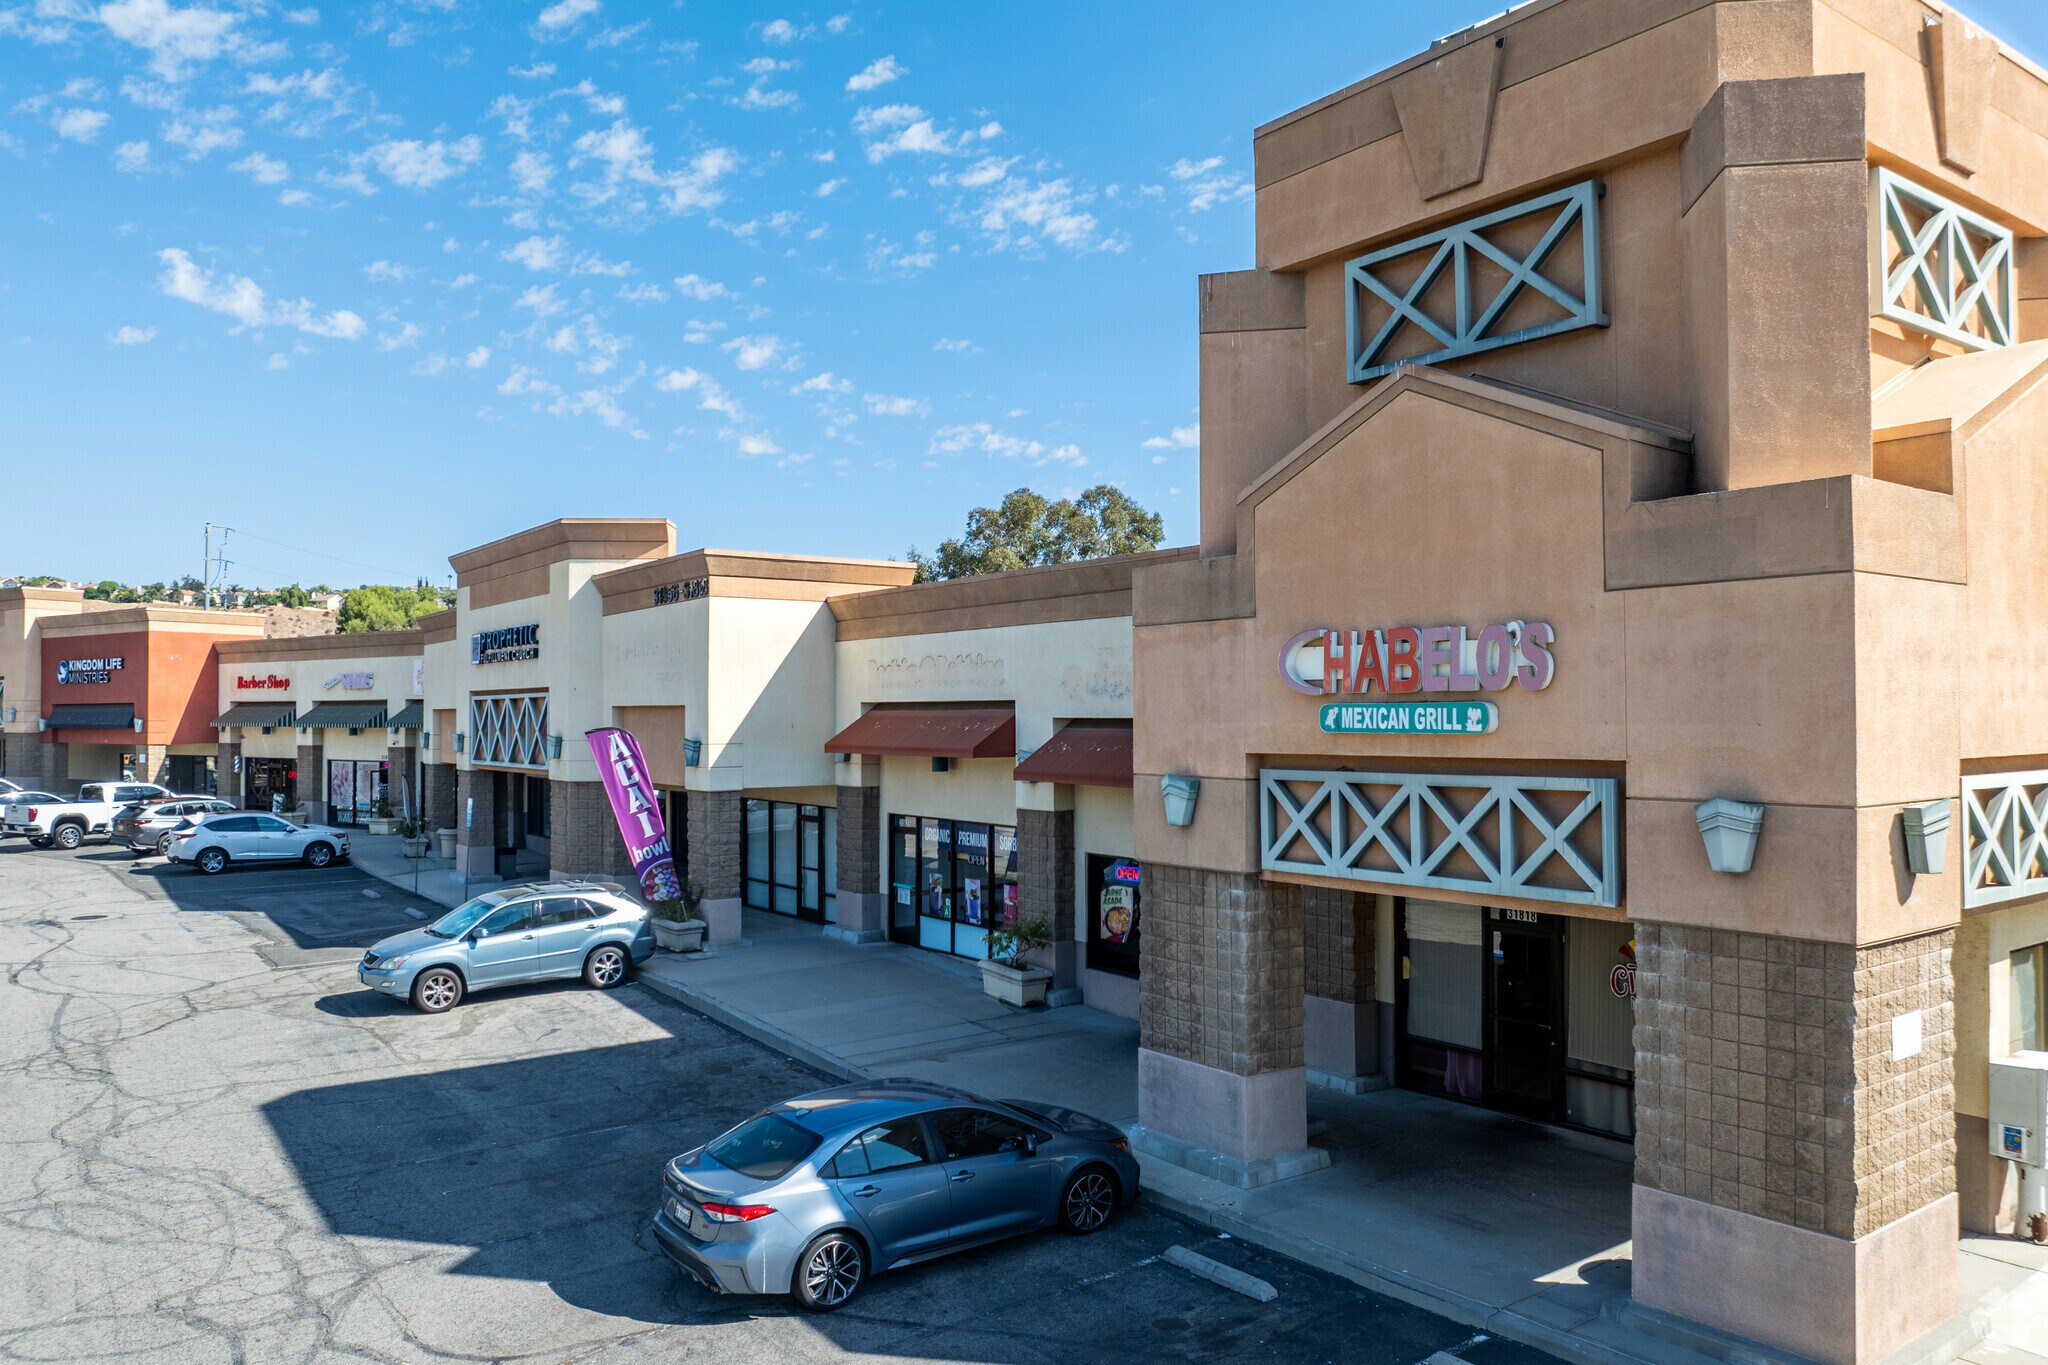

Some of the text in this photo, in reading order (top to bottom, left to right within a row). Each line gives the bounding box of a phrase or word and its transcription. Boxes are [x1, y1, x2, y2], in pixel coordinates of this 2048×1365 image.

[480, 624, 538, 651] PROPHETIC
[511, 648, 535, 661] CHURCH
[1278, 620, 1555, 696] CHABELO'S
[69, 657, 122, 671] KINGDOM LIFE
[69, 671, 108, 684] MINISTRIES
[237, 674, 290, 691] Barber Shop
[1341, 707, 1463, 731] MEXICAN GRILL
[924, 827, 951, 844] ORGANIC
[958, 831, 987, 848] PREMIUM
[632, 835, 671, 863] bowl
[967, 854, 985, 866] OPEN
[1116, 867, 1139, 881] OPEN
[1507, 908, 1536, 921] 31818
